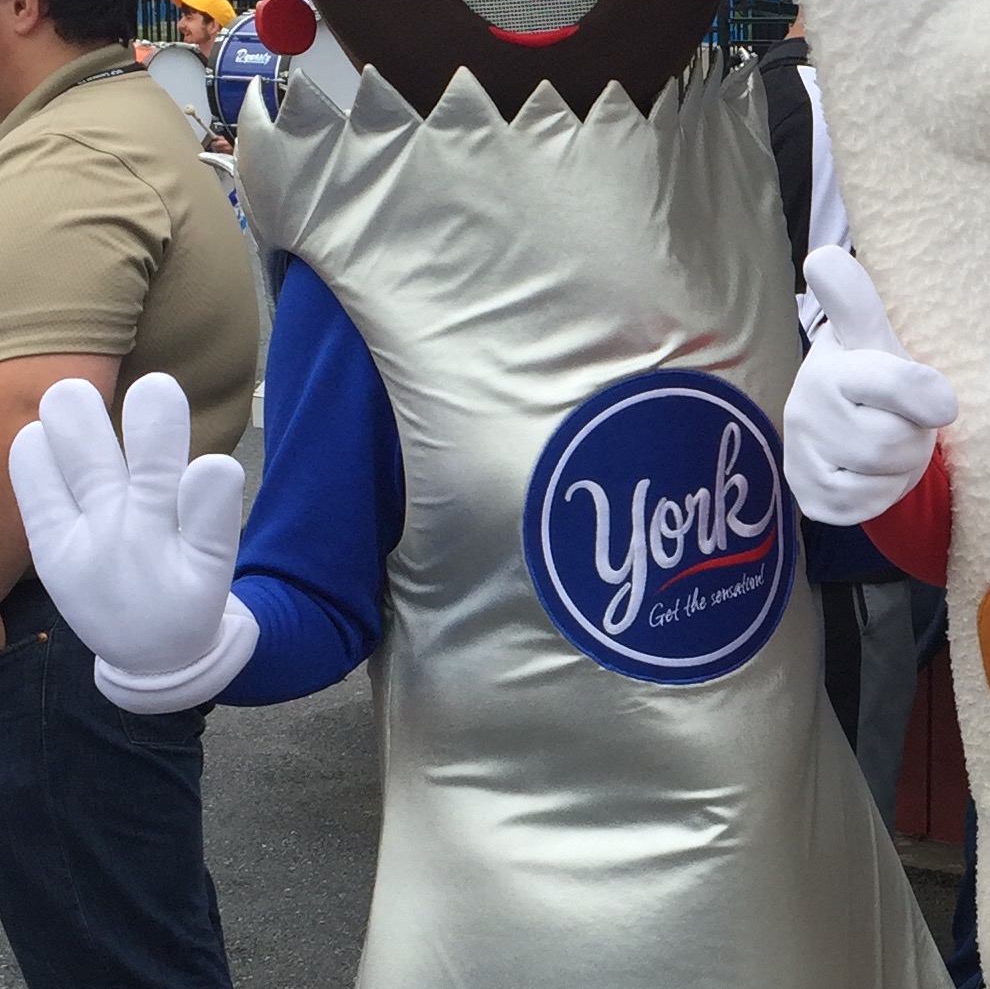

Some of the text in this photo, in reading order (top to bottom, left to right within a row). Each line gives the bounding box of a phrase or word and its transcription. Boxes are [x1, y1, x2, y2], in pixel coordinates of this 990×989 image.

[565, 421, 777, 635] York
[649, 598, 680, 627] Get
[684, 587, 707, 617] the
